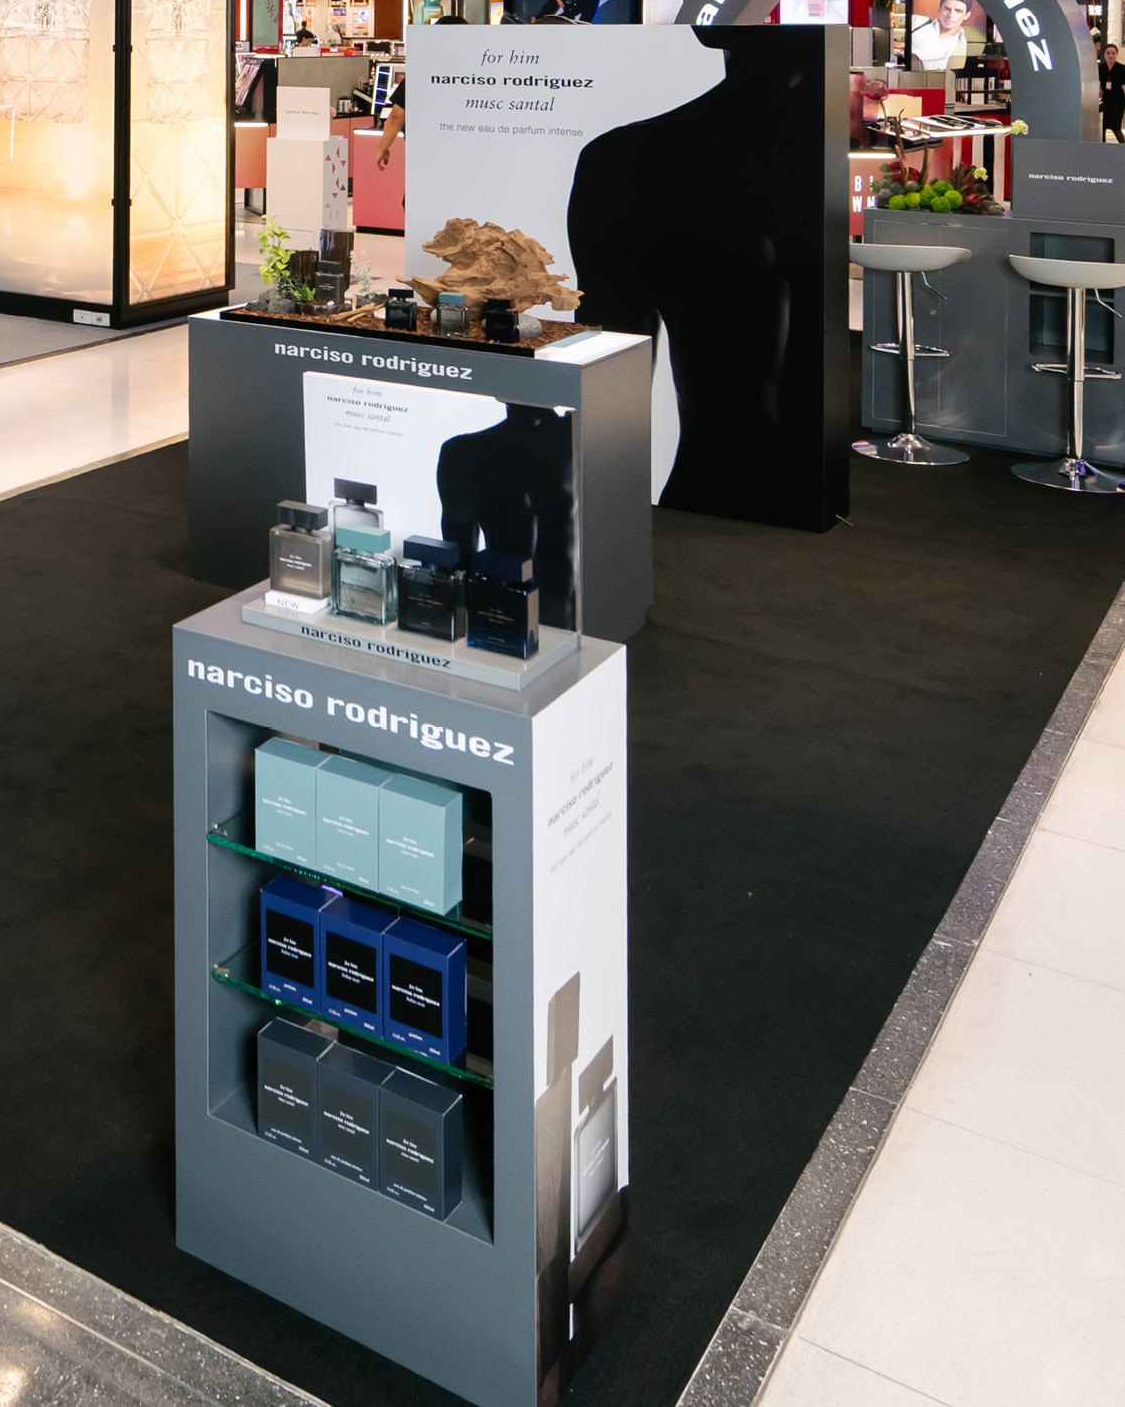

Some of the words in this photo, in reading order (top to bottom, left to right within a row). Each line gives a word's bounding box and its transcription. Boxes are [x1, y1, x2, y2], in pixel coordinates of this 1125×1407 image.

[481, 49, 504, 66] for
[509, 50, 540, 65] him
[431, 74, 497, 86] narciso
[503, 75, 594, 90] rodriguez
[465, 98, 504, 110] musc
[508, 97, 555, 111] santal
[440, 123, 454, 131] the
[457, 124, 475, 132] new
[498, 125, 509, 134] de
[512, 126, 545, 135] parfum
[548, 127, 583, 137] intense
[1066, 176, 1114, 184] rodriguez
[275, 341, 354, 364] narciso
[361, 352, 473, 381] rodriguez
[352, 385, 364, 395] for
[327, 395, 361, 406] narciso
[364, 400, 409, 413] rodriguez
[345, 410, 364, 419] musc
[367, 414, 390, 422] santal
[277, 598, 299, 609] NEW
[301, 625, 361, 648] narciso
[367, 640, 451, 669] rodriguez
[187, 658, 314, 709] narciso
[327, 695, 515, 766] rodriguez
[548, 796, 577, 827] narciso
[578, 761, 614, 800] rodriguez
